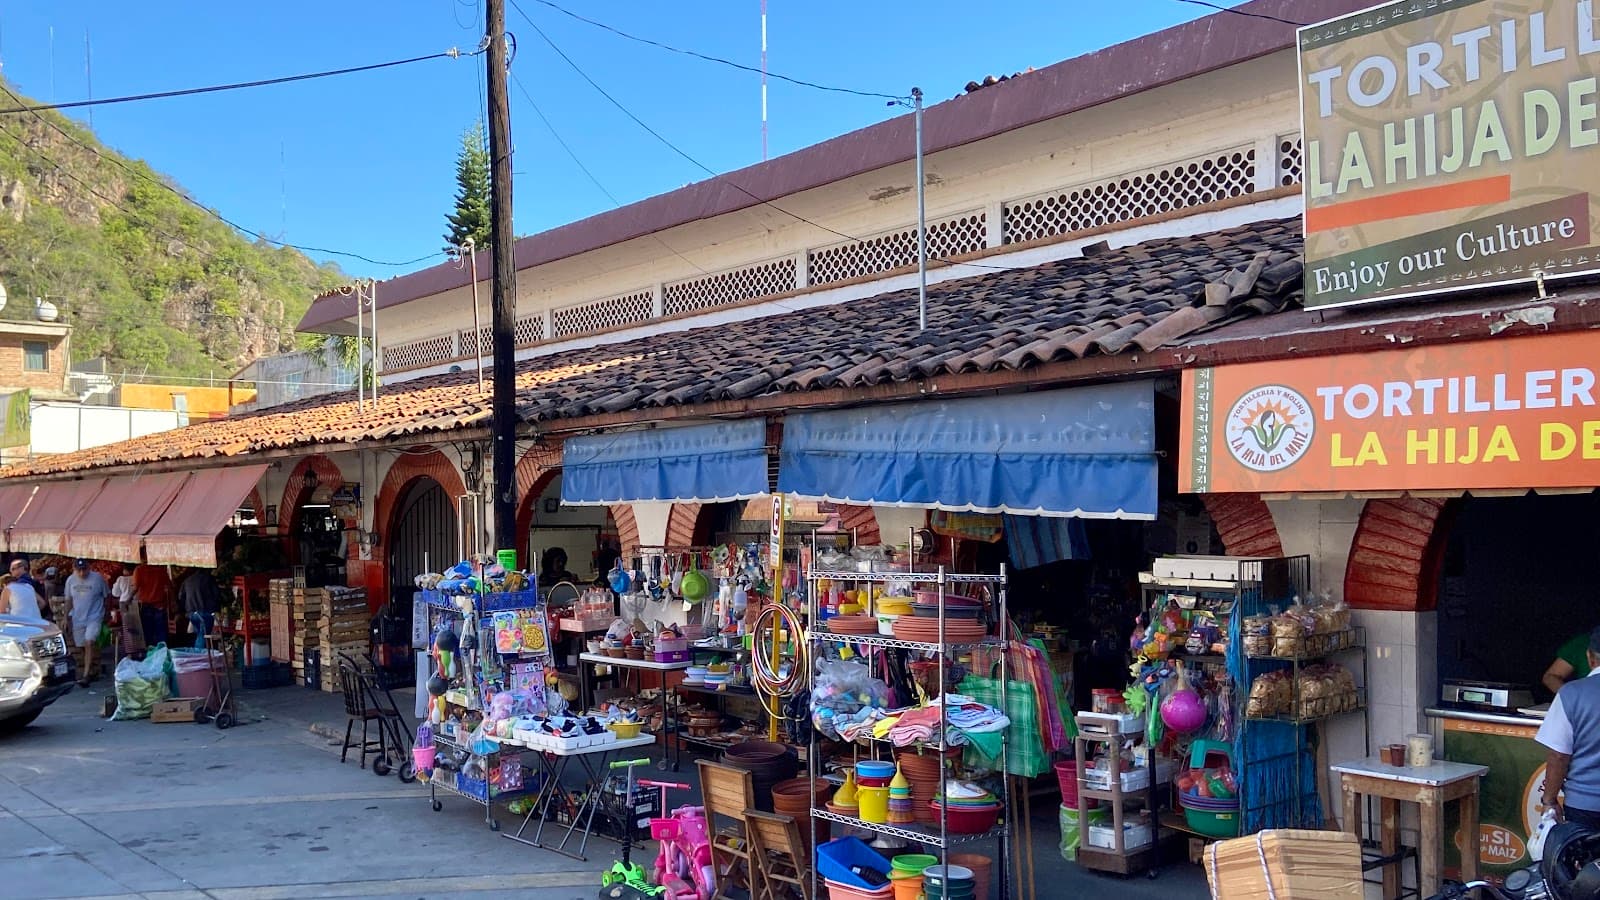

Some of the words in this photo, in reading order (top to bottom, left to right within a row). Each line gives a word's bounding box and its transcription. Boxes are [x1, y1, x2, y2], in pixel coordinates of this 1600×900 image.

[1308, 0, 1600, 118] TORTILL
[1309, 131, 1374, 199] LA
[1384, 100, 1512, 184] HIJA
[1313, 260, 1390, 295] Enjoy
[1398, 246, 1446, 275] our
[1456, 217, 1575, 261] Culture
[1233, 389, 1275, 418] TORTILLERIA
[1283, 391, 1306, 415] MOLINO
[1316, 367, 1596, 420] TORTILLER
[1231, 437, 1245, 452] LA
[1241, 448, 1265, 466] HIJA
[1269, 453, 1286, 466] DEL
[1285, 431, 1308, 456] MAIZ
[1331, 431, 1388, 467] LA
[1406, 425, 1521, 465] HIJA
[1488, 845, 1517, 859] MAIZ
[1491, 831, 1510, 846] SI
